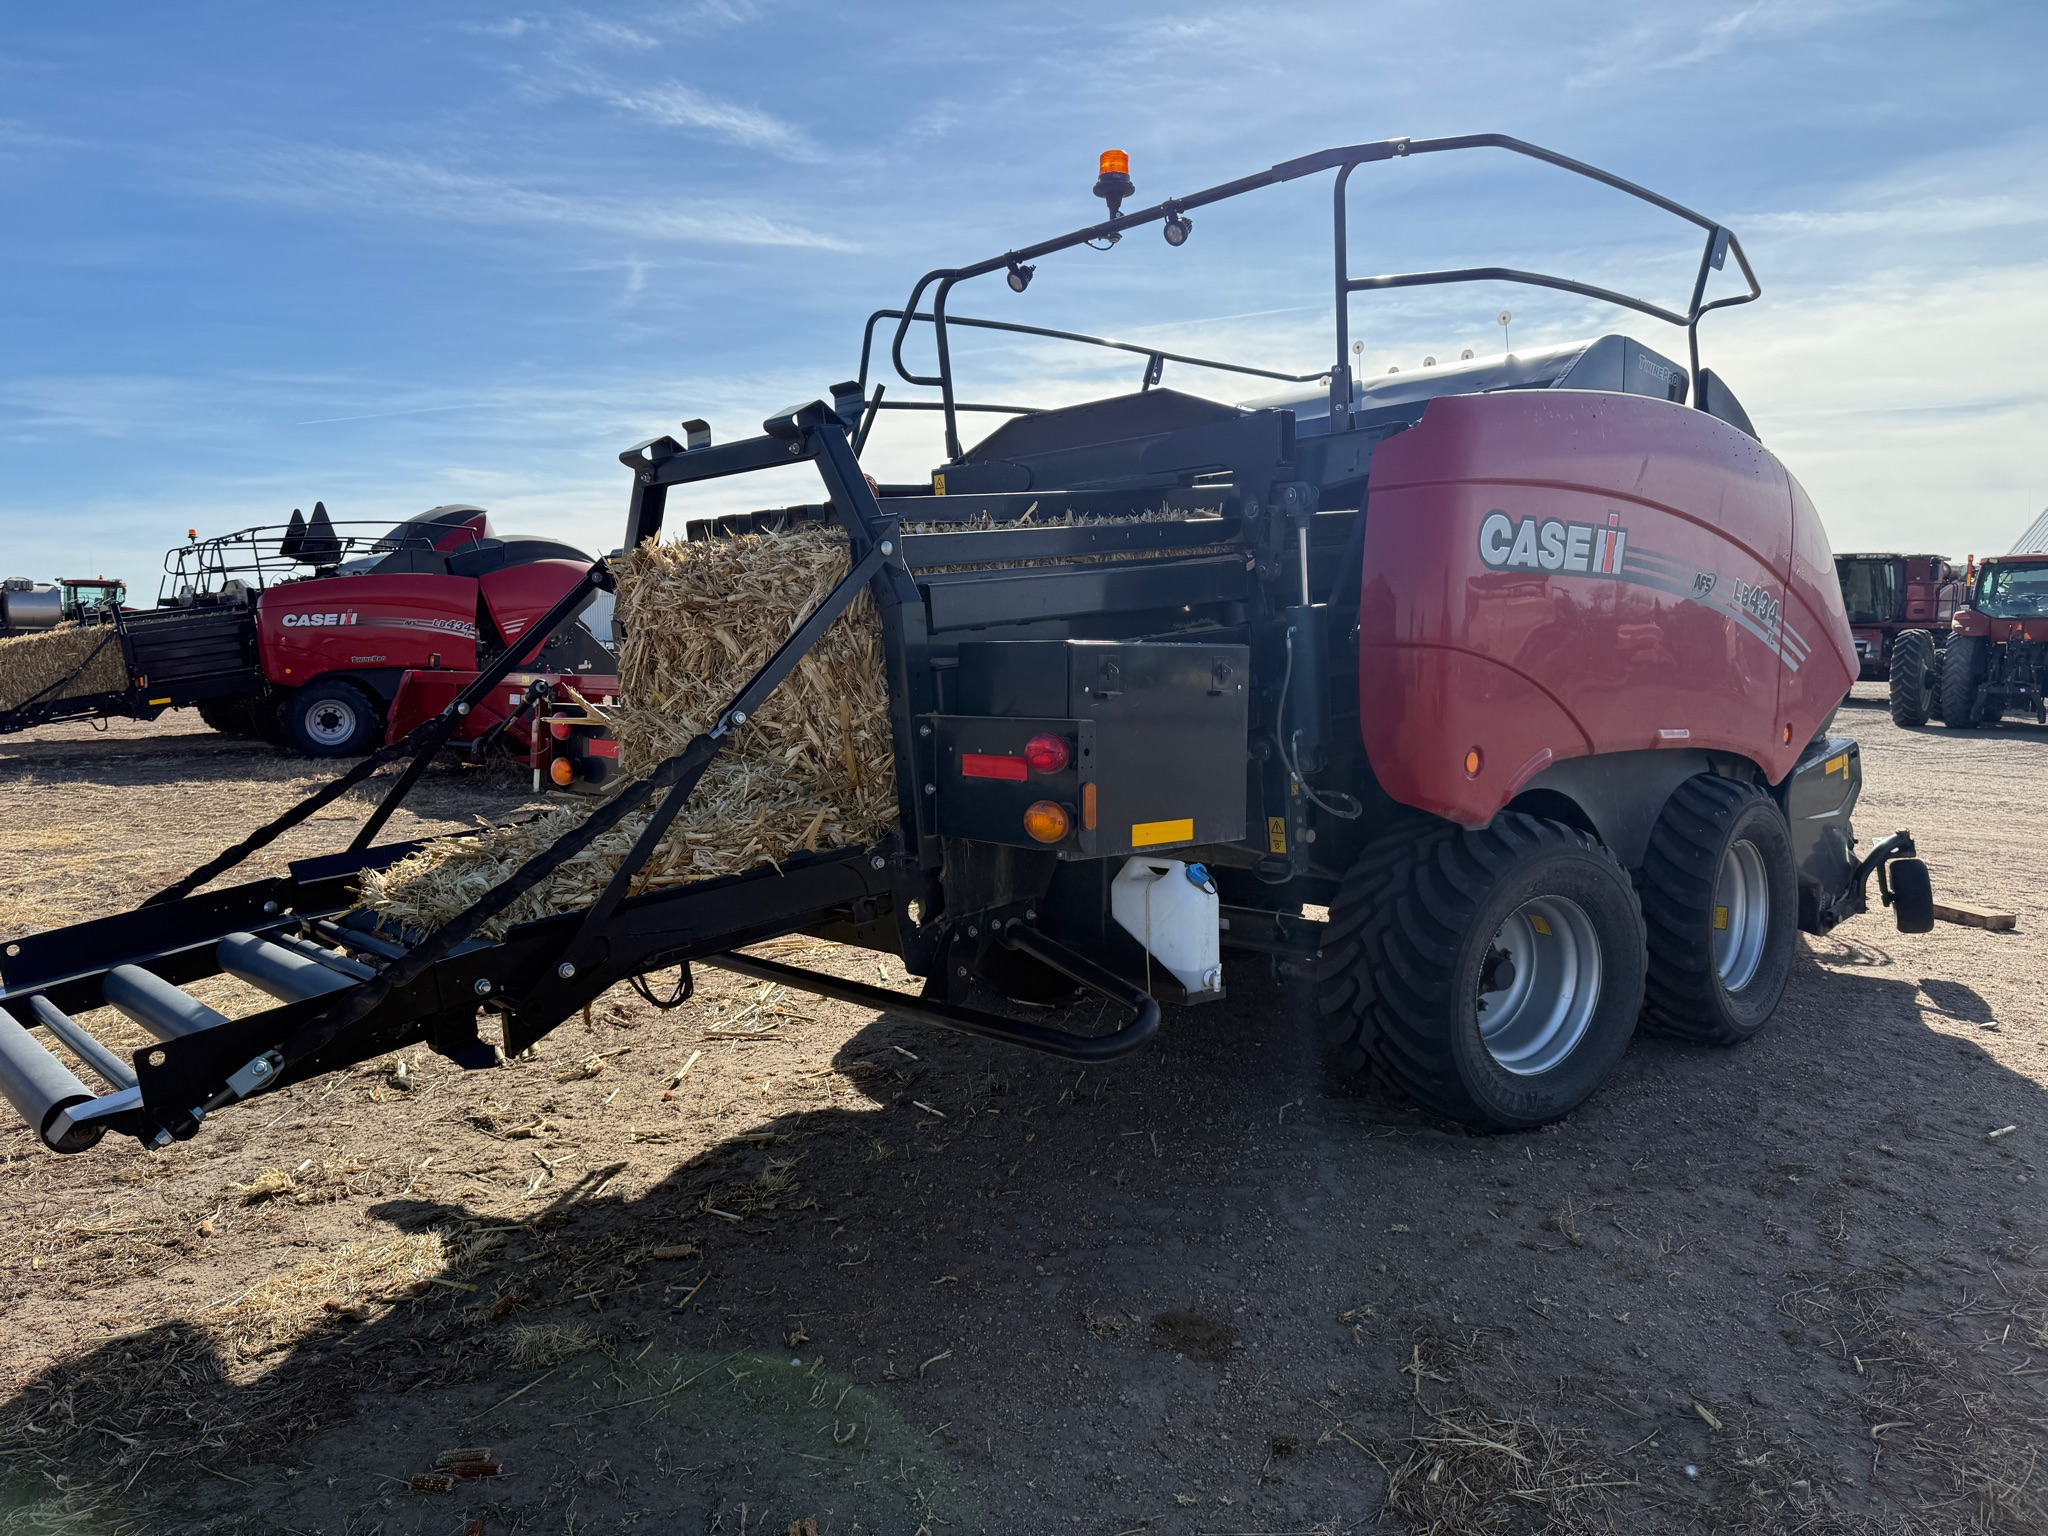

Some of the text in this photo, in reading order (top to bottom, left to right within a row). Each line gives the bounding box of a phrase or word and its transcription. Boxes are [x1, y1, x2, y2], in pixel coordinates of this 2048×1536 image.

[1479, 512, 1593, 573] CASE
[1693, 572, 1712, 593] AFS
[282, 613, 339, 627] CASE
[1732, 577, 1780, 629] LB434
